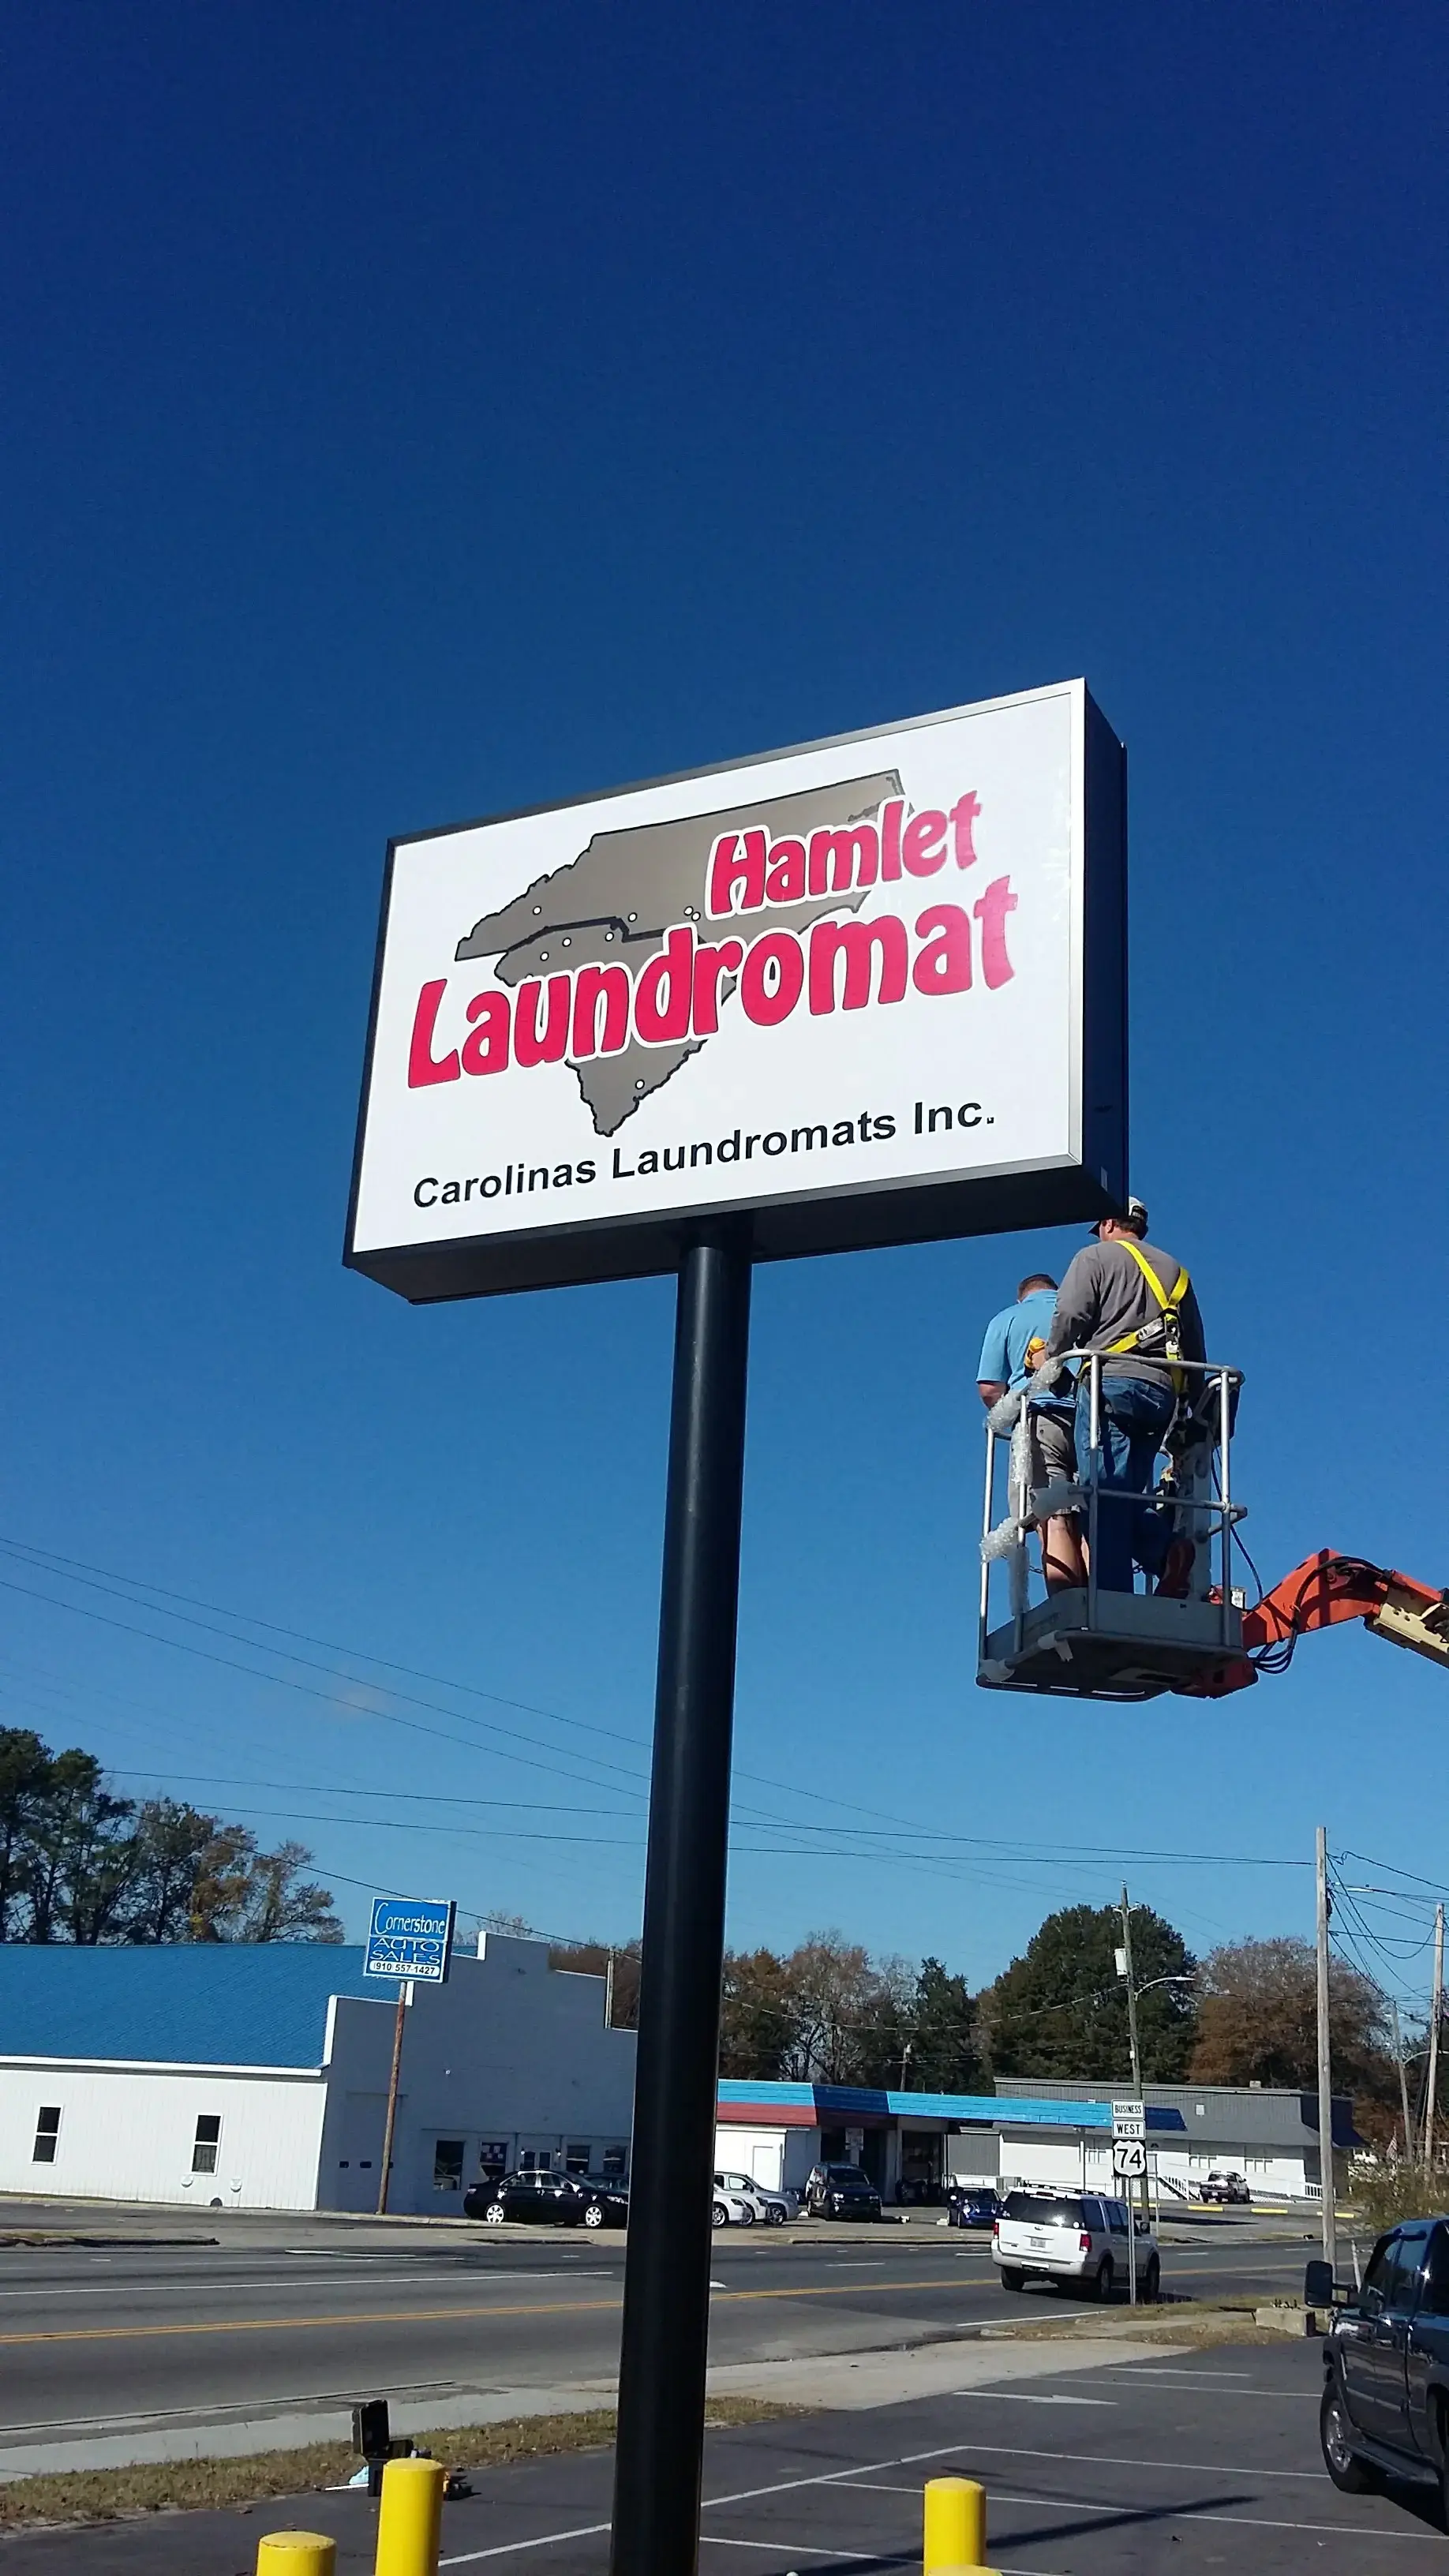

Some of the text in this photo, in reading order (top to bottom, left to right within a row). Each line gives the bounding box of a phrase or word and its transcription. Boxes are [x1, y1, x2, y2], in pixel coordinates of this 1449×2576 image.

[710, 790, 982, 915] Hamlet
[406, 874, 1018, 1089] Laundromat
[414, 1101, 995, 1208] Carolinas Laundromats Inc.
[374, 1902, 446, 1935] Cornerstone
[373, 1938, 440, 1953] AUTO
[369, 1949, 440, 1965] SALES
[395, 1964, 436, 1975] 557-1427
[1114, 2104, 1142, 2114] BUSINESS
[1116, 2123, 1141, 2135] WEST
[1116, 2148, 1142, 2169] 74
